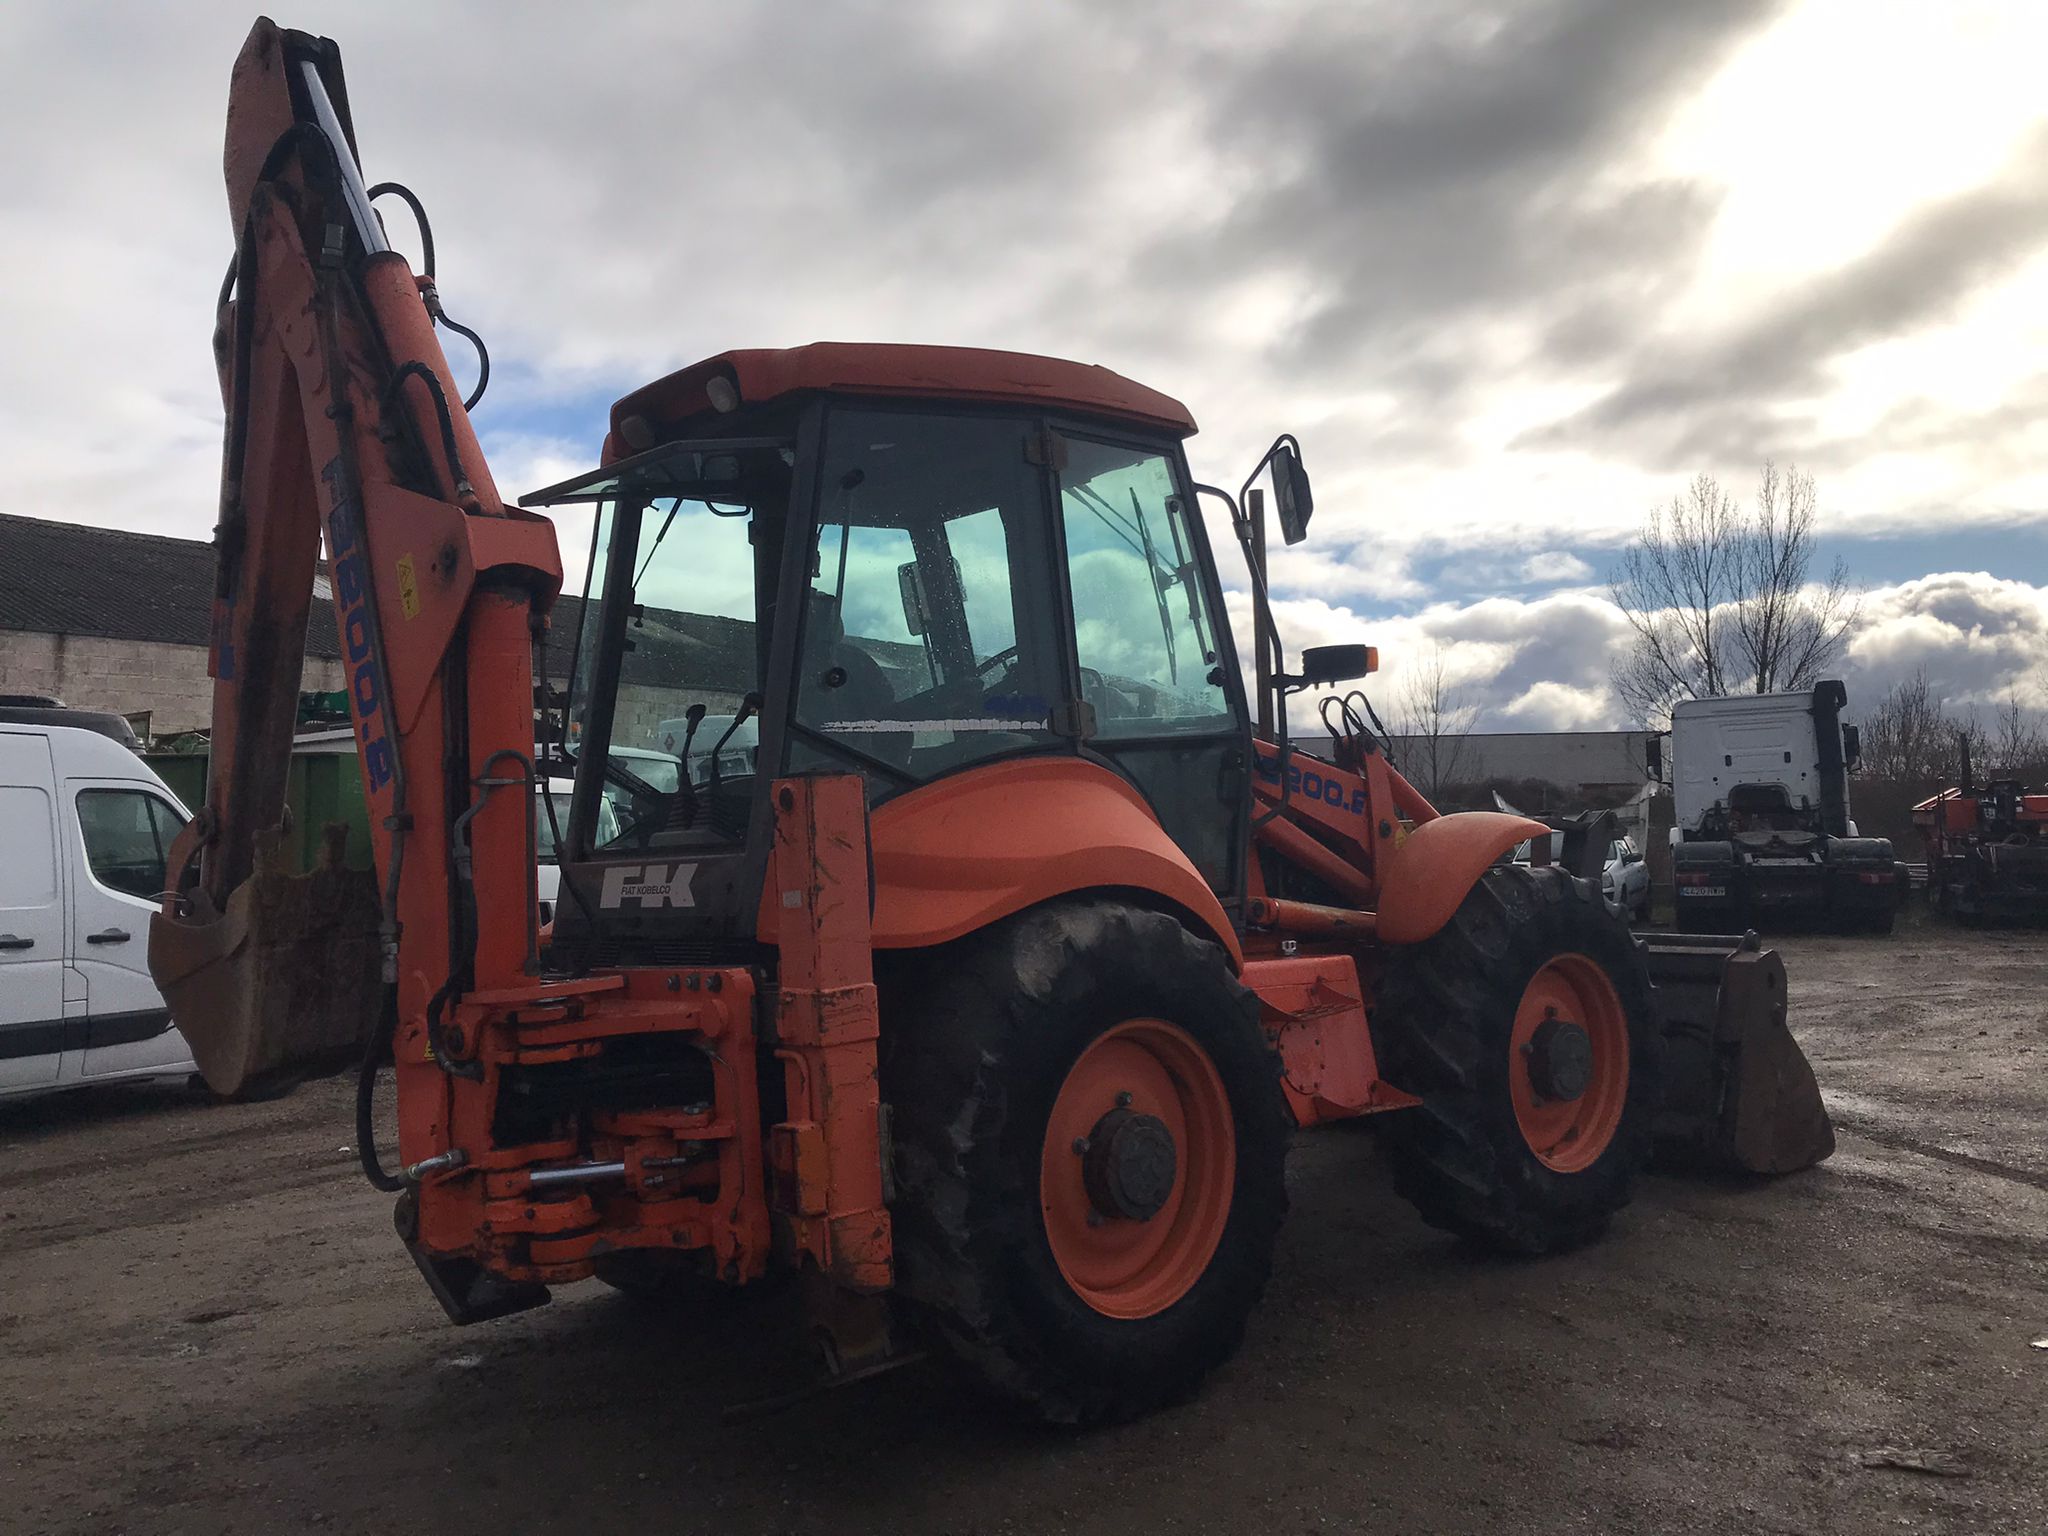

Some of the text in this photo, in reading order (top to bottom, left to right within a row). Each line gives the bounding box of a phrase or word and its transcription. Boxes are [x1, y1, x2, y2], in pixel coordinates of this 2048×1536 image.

[600, 863, 698, 908] FK
[621, 885, 671, 895] FIAT KOBELCO
